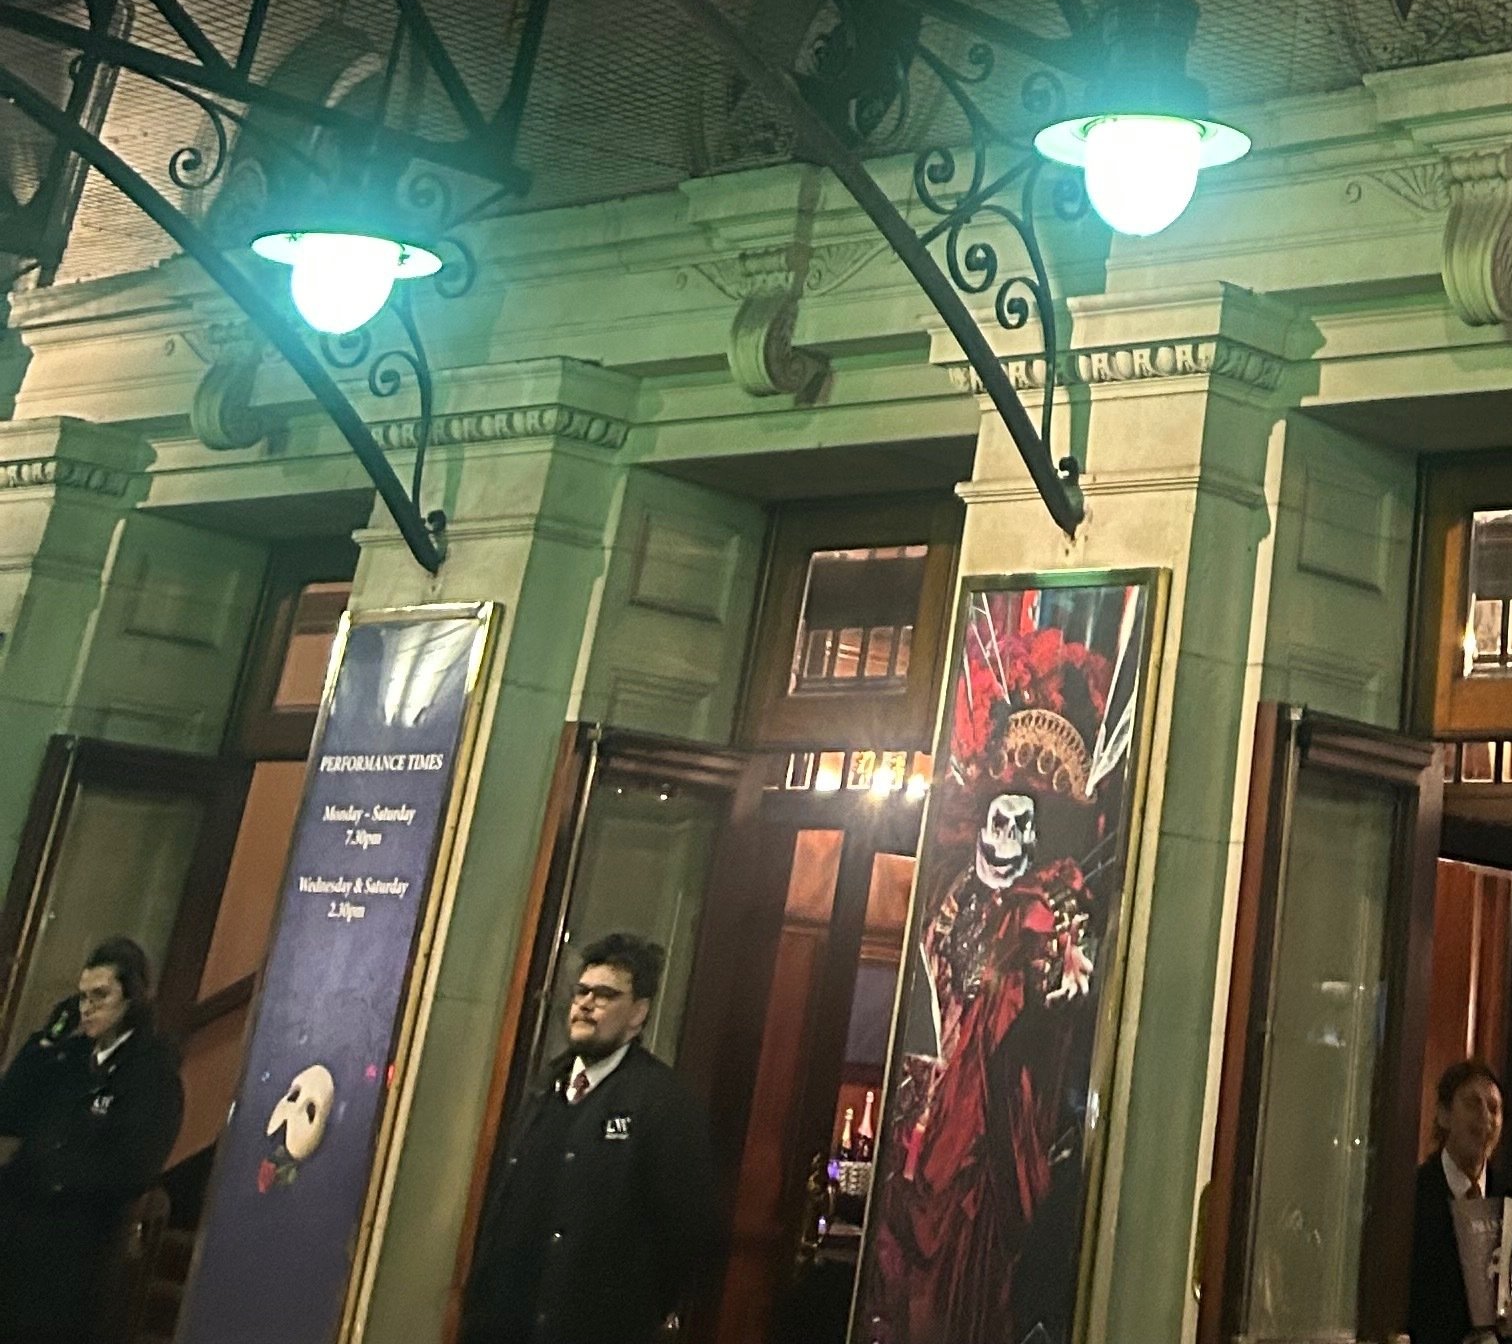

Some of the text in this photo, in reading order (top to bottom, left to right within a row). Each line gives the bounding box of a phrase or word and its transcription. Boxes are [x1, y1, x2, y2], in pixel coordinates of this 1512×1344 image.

[320, 753, 443, 773] PERFORMANCE TIMES
[322, 804, 364, 825] Monday
[371, 803, 417, 825] Saturday
[344, 829, 383, 851] 7.30pm
[299, 875, 409, 899] Wednesday & Saturday
[327, 901, 366, 923] 2.30pm
